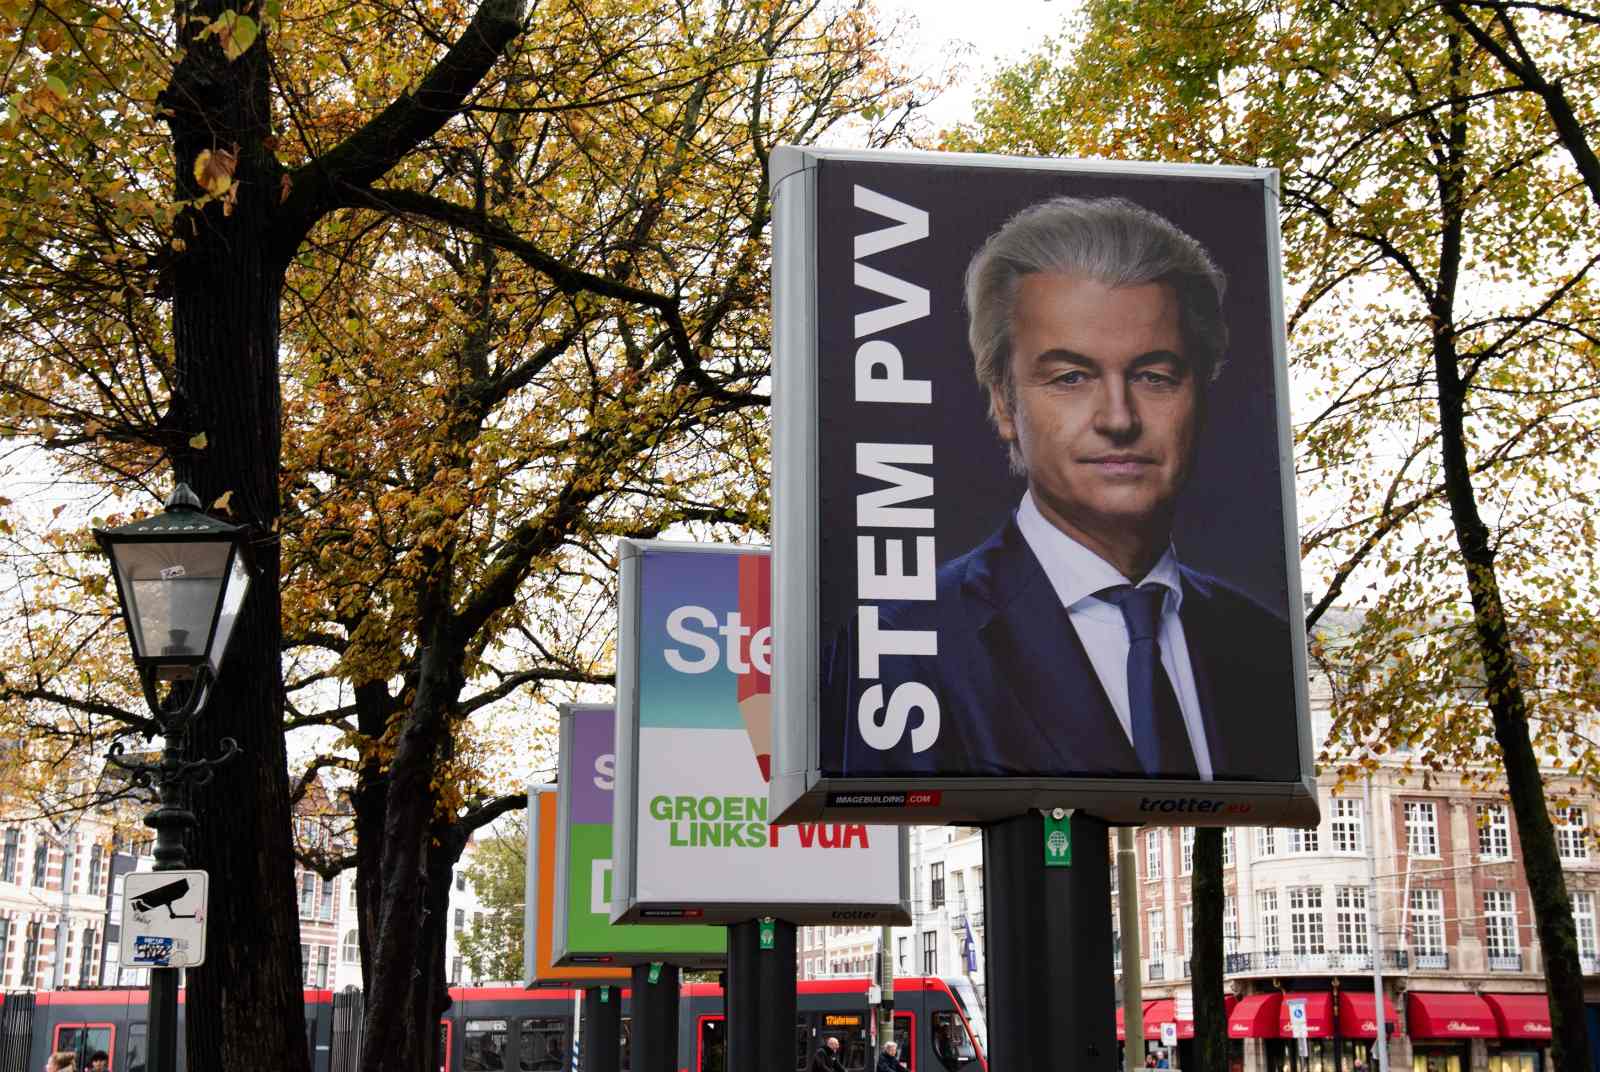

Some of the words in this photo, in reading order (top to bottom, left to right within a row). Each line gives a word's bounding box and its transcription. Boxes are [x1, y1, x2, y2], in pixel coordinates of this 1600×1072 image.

[854, 184, 933, 404] PVV
[855, 443, 941, 753] STEM
[650, 796, 768, 821] GROEN
[835, 795, 905, 804] IMAGEBUILDING
[1139, 797, 1225, 813] trotter
[670, 823, 767, 848] LINKS
